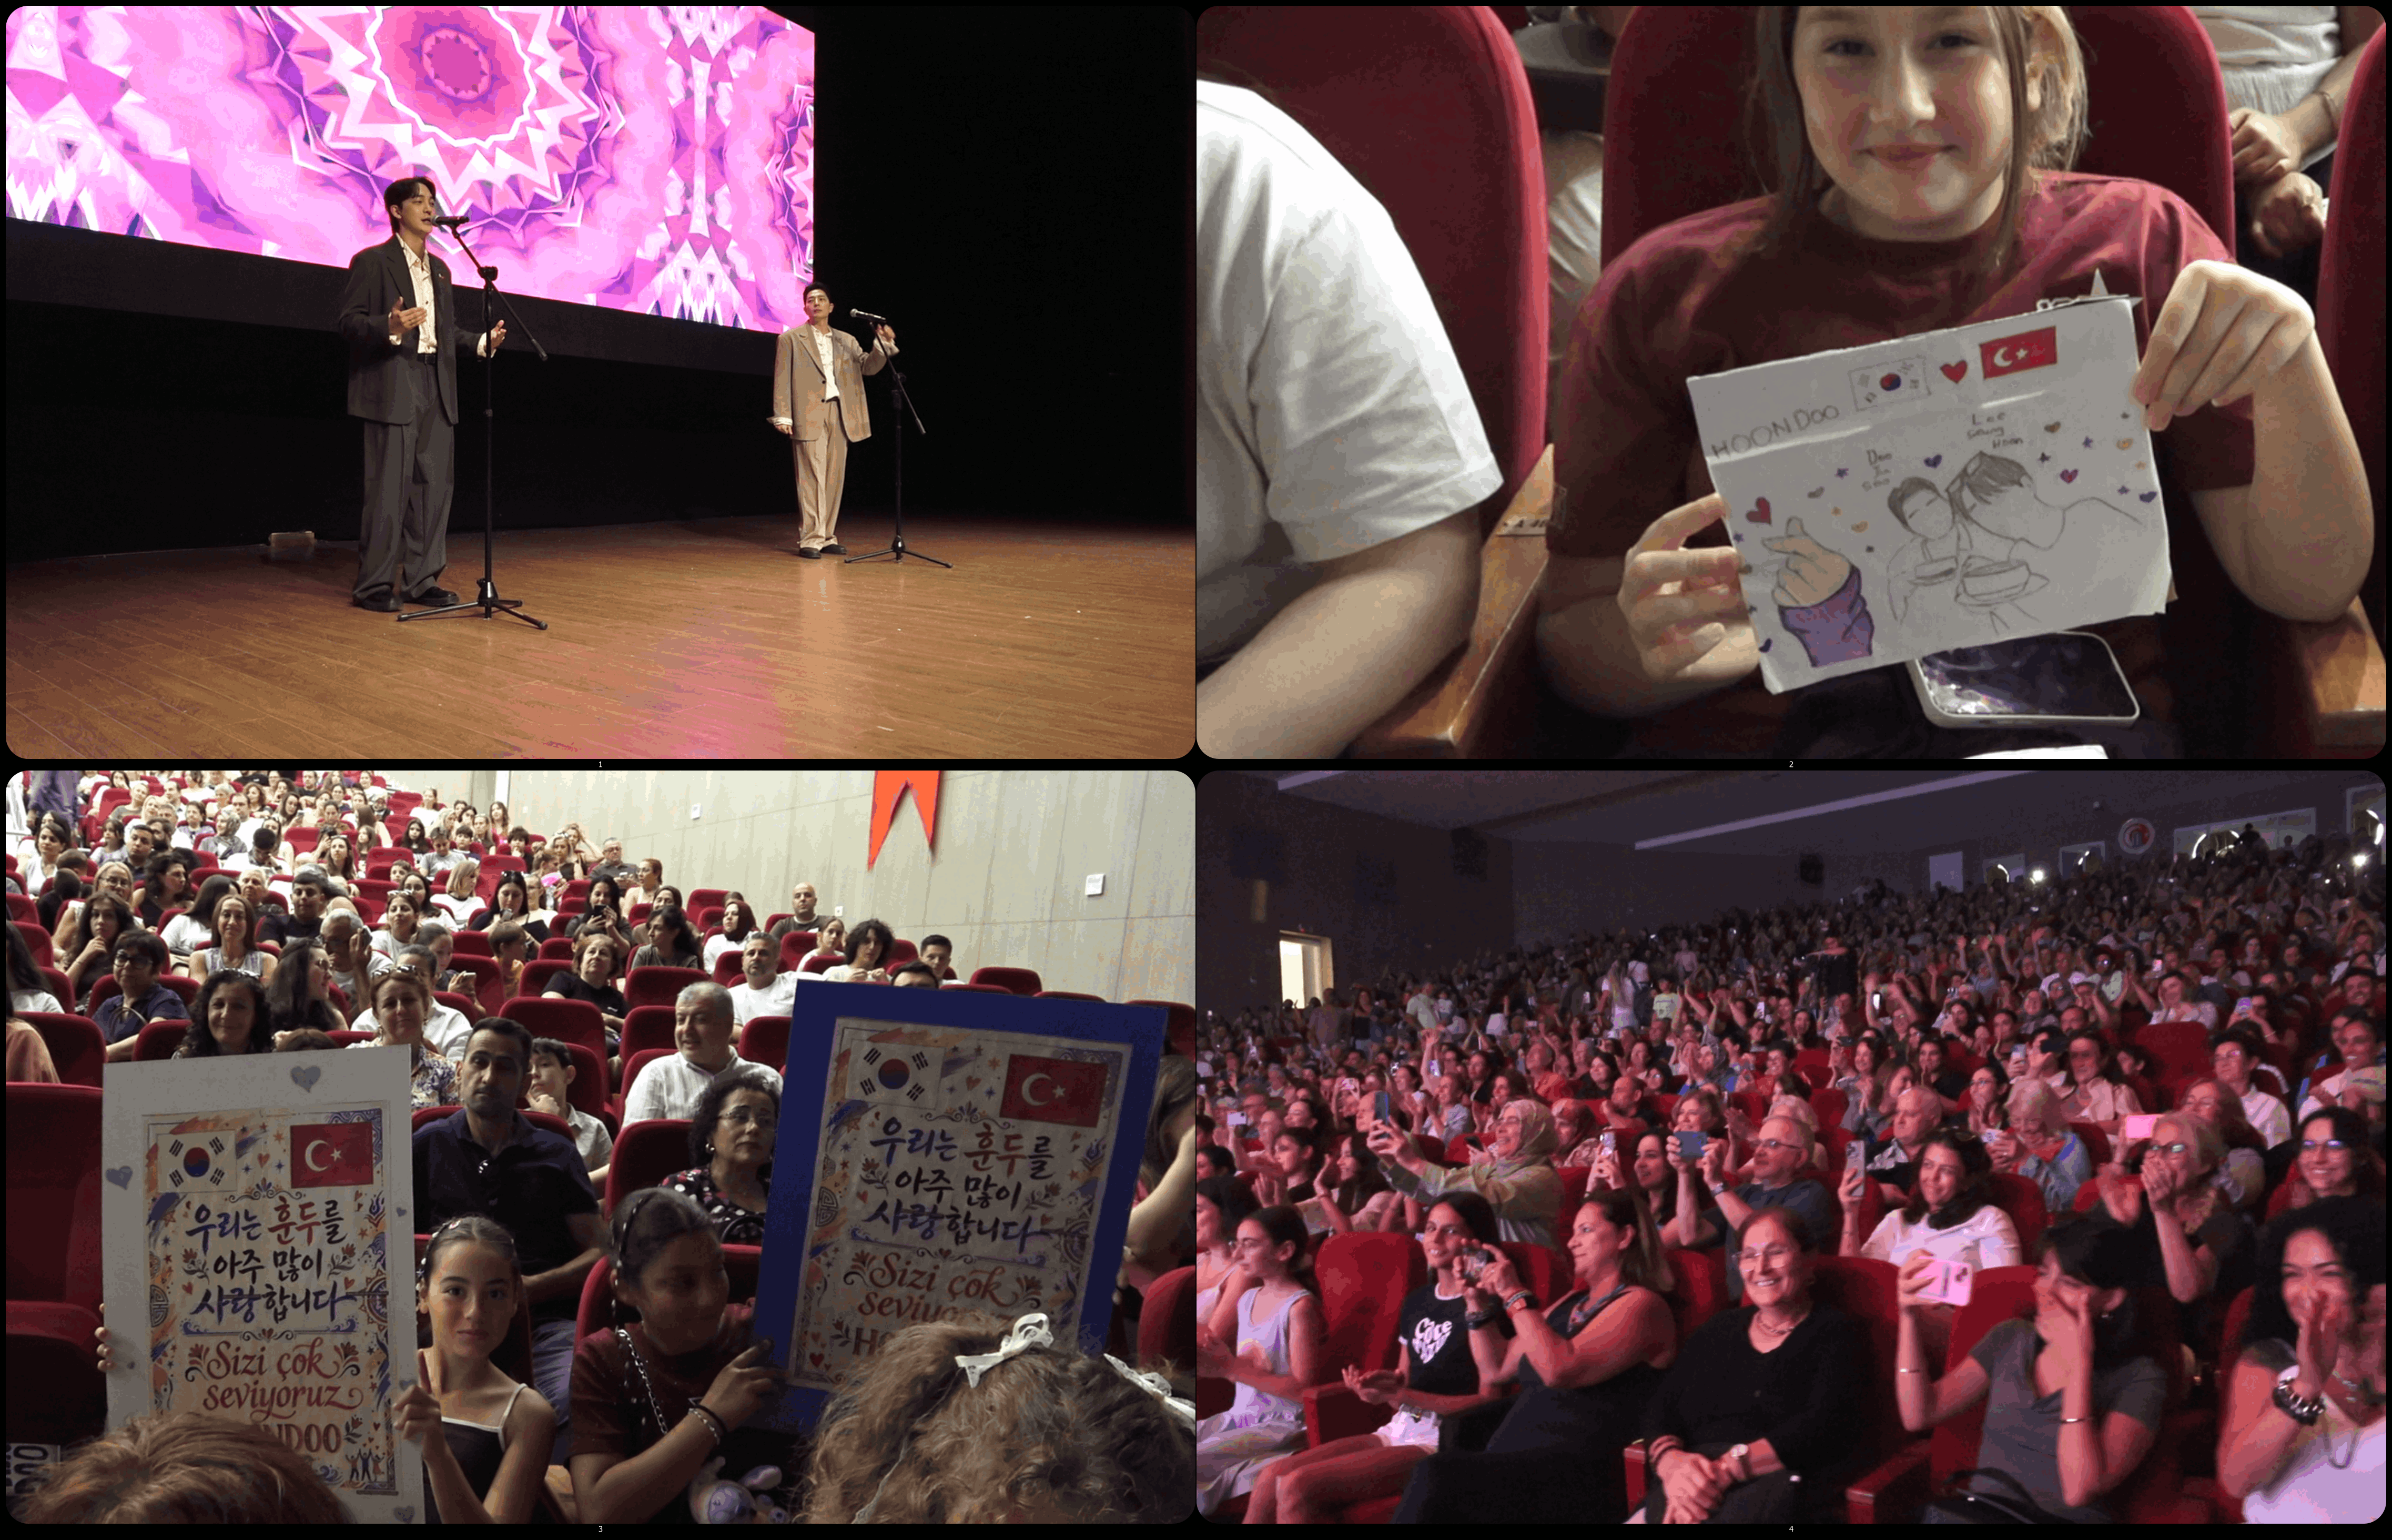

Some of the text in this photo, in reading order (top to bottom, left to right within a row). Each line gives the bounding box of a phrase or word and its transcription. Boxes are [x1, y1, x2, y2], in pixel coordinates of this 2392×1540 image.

[870, 1116, 1056, 1180] 우리는 훈두를
[895, 1167, 1022, 1211] 아주 많이
[185, 1195, 348, 1256] 우리는 훈두를
[861, 1198, 1053, 1254] 사랑합니다
[213, 1245, 322, 1285] 아주 많이
[869, 1252, 1019, 1308] Sizi çok
[189, 1280, 358, 1325] 사랑합니다
[207, 1336, 340, 1382] Sizi çok
[202, 1379, 364, 1423] seviyoruz
